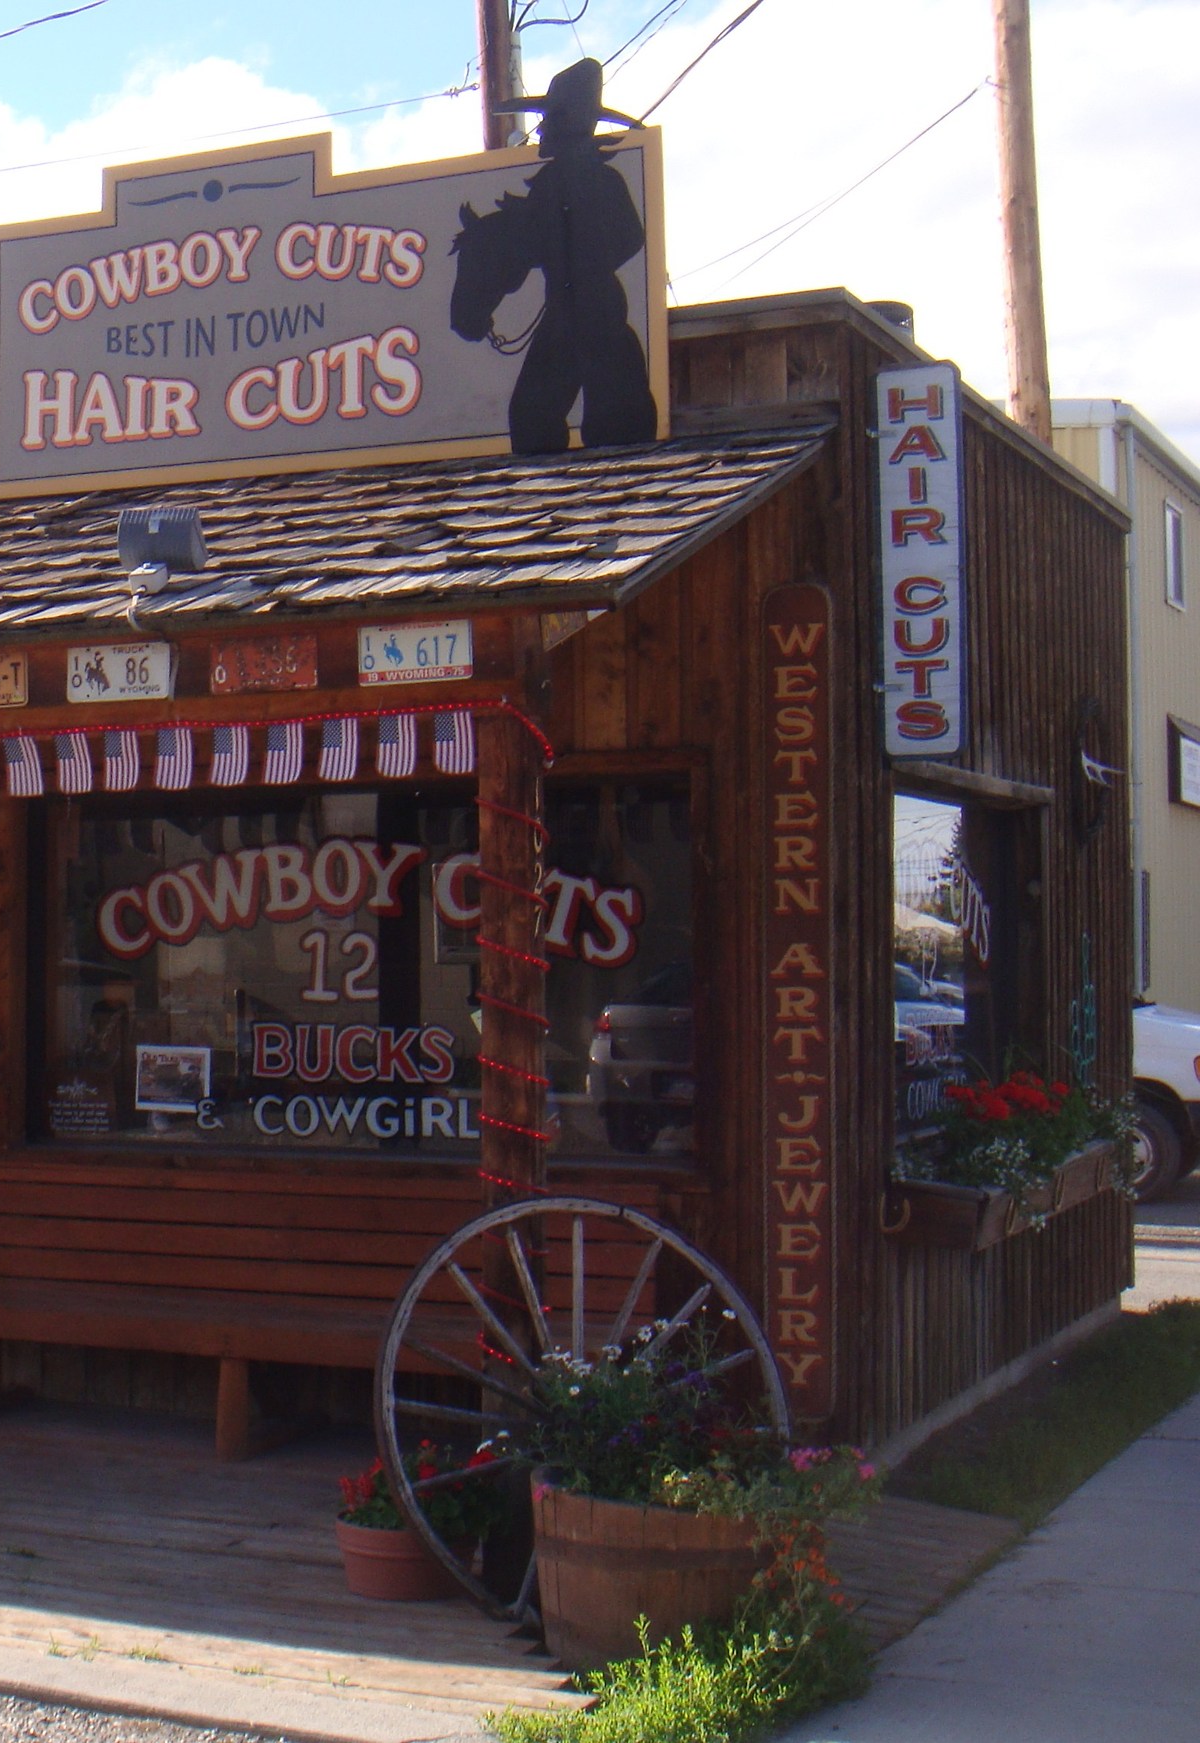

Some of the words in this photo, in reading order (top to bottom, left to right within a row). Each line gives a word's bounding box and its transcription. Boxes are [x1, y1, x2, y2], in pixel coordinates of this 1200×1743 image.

[19, 226, 260, 334] COWBOY
[274, 222, 426, 289] CUTS
[107, 321, 171, 359] BEST
[185, 316, 217, 357] IN
[226, 303, 325, 351] TOWN
[20, 370, 201, 450] HAIR
[225, 327, 422, 431] CUTS
[887, 384, 946, 546] HAIR
[112, 646, 145, 655] TRUCK
[126, 656, 149, 685] 86
[385, 668, 445, 681] WYOMING
[416, 633, 457, 667] 617
[893, 576, 949, 739] CUTS
[119, 684, 160, 694] WYOMING
[769, 622, 824, 915] WESTERN
[98, 837, 425, 960] COWBOY
[434, 853, 643, 969] CTS
[301, 929, 381, 1001] 12
[252, 1023, 455, 1083] BUCKS
[773, 1095, 827, 1385] JEWELRY
